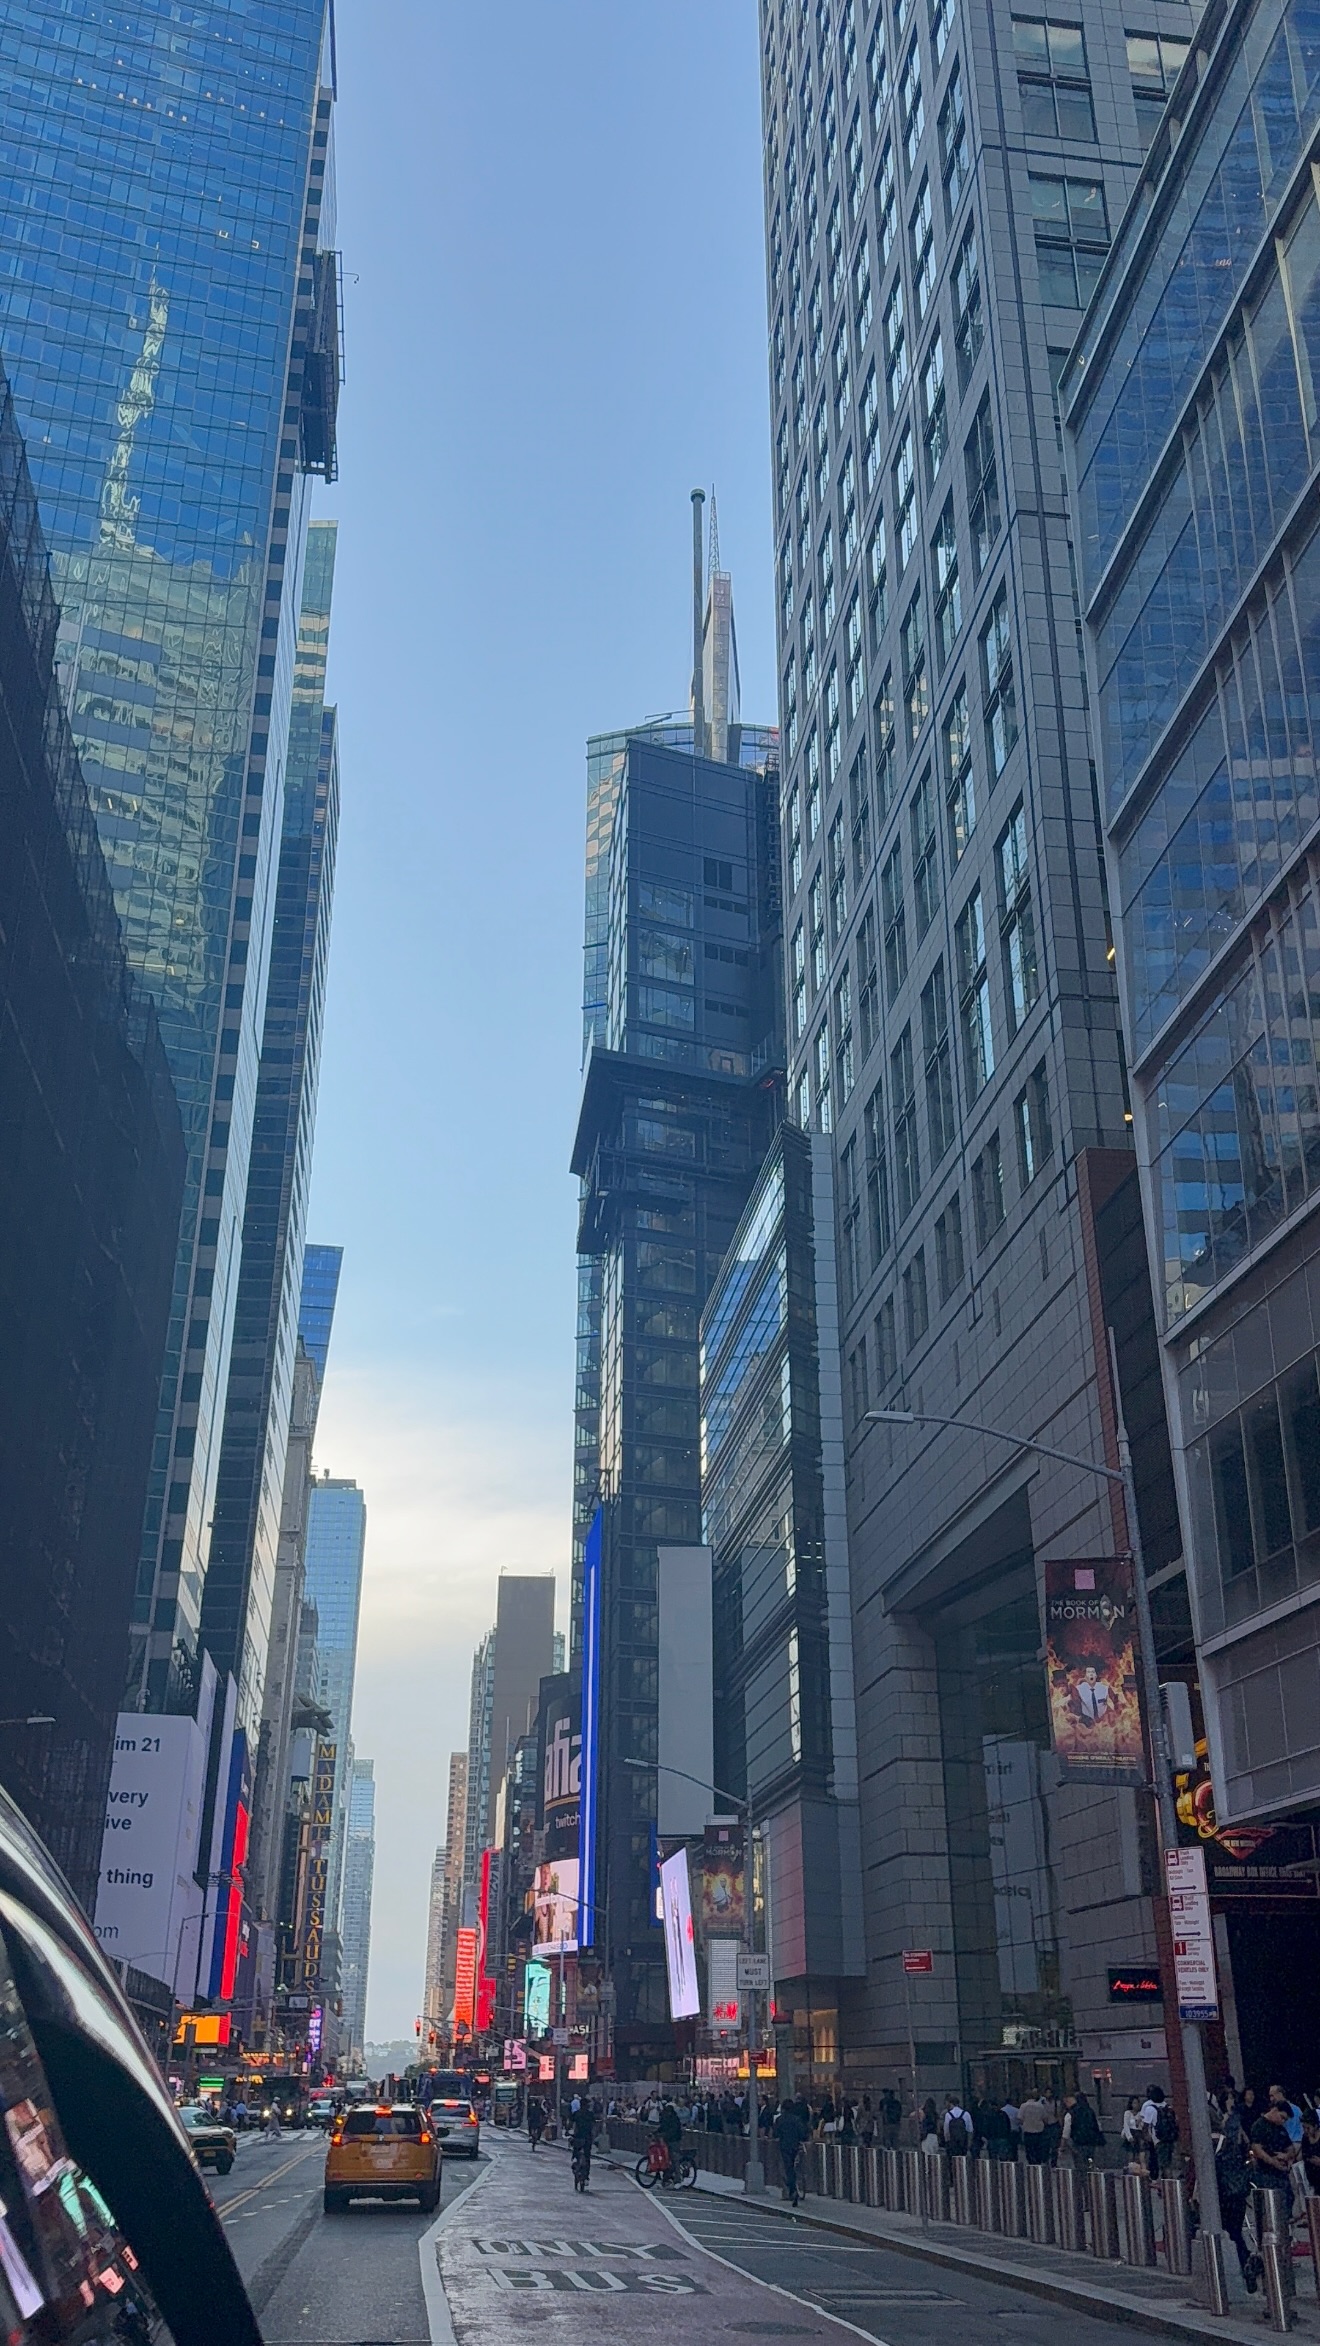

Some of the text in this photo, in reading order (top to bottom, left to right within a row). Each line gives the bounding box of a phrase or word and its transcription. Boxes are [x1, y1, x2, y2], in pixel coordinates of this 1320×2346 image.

[1050, 1604, 1126, 1621] MORMON
[141, 1737, 161, 1752] 21
[109, 1791, 149, 1808] very
[314, 1744, 336, 1840] MADAME
[555, 1812, 582, 1829] twitch
[106, 1868, 154, 1888] thing
[304, 1859, 326, 1992] TUSSAUDS
[476, 2240, 661, 2260] ONLY
[489, 2268, 696, 2295] BUS
